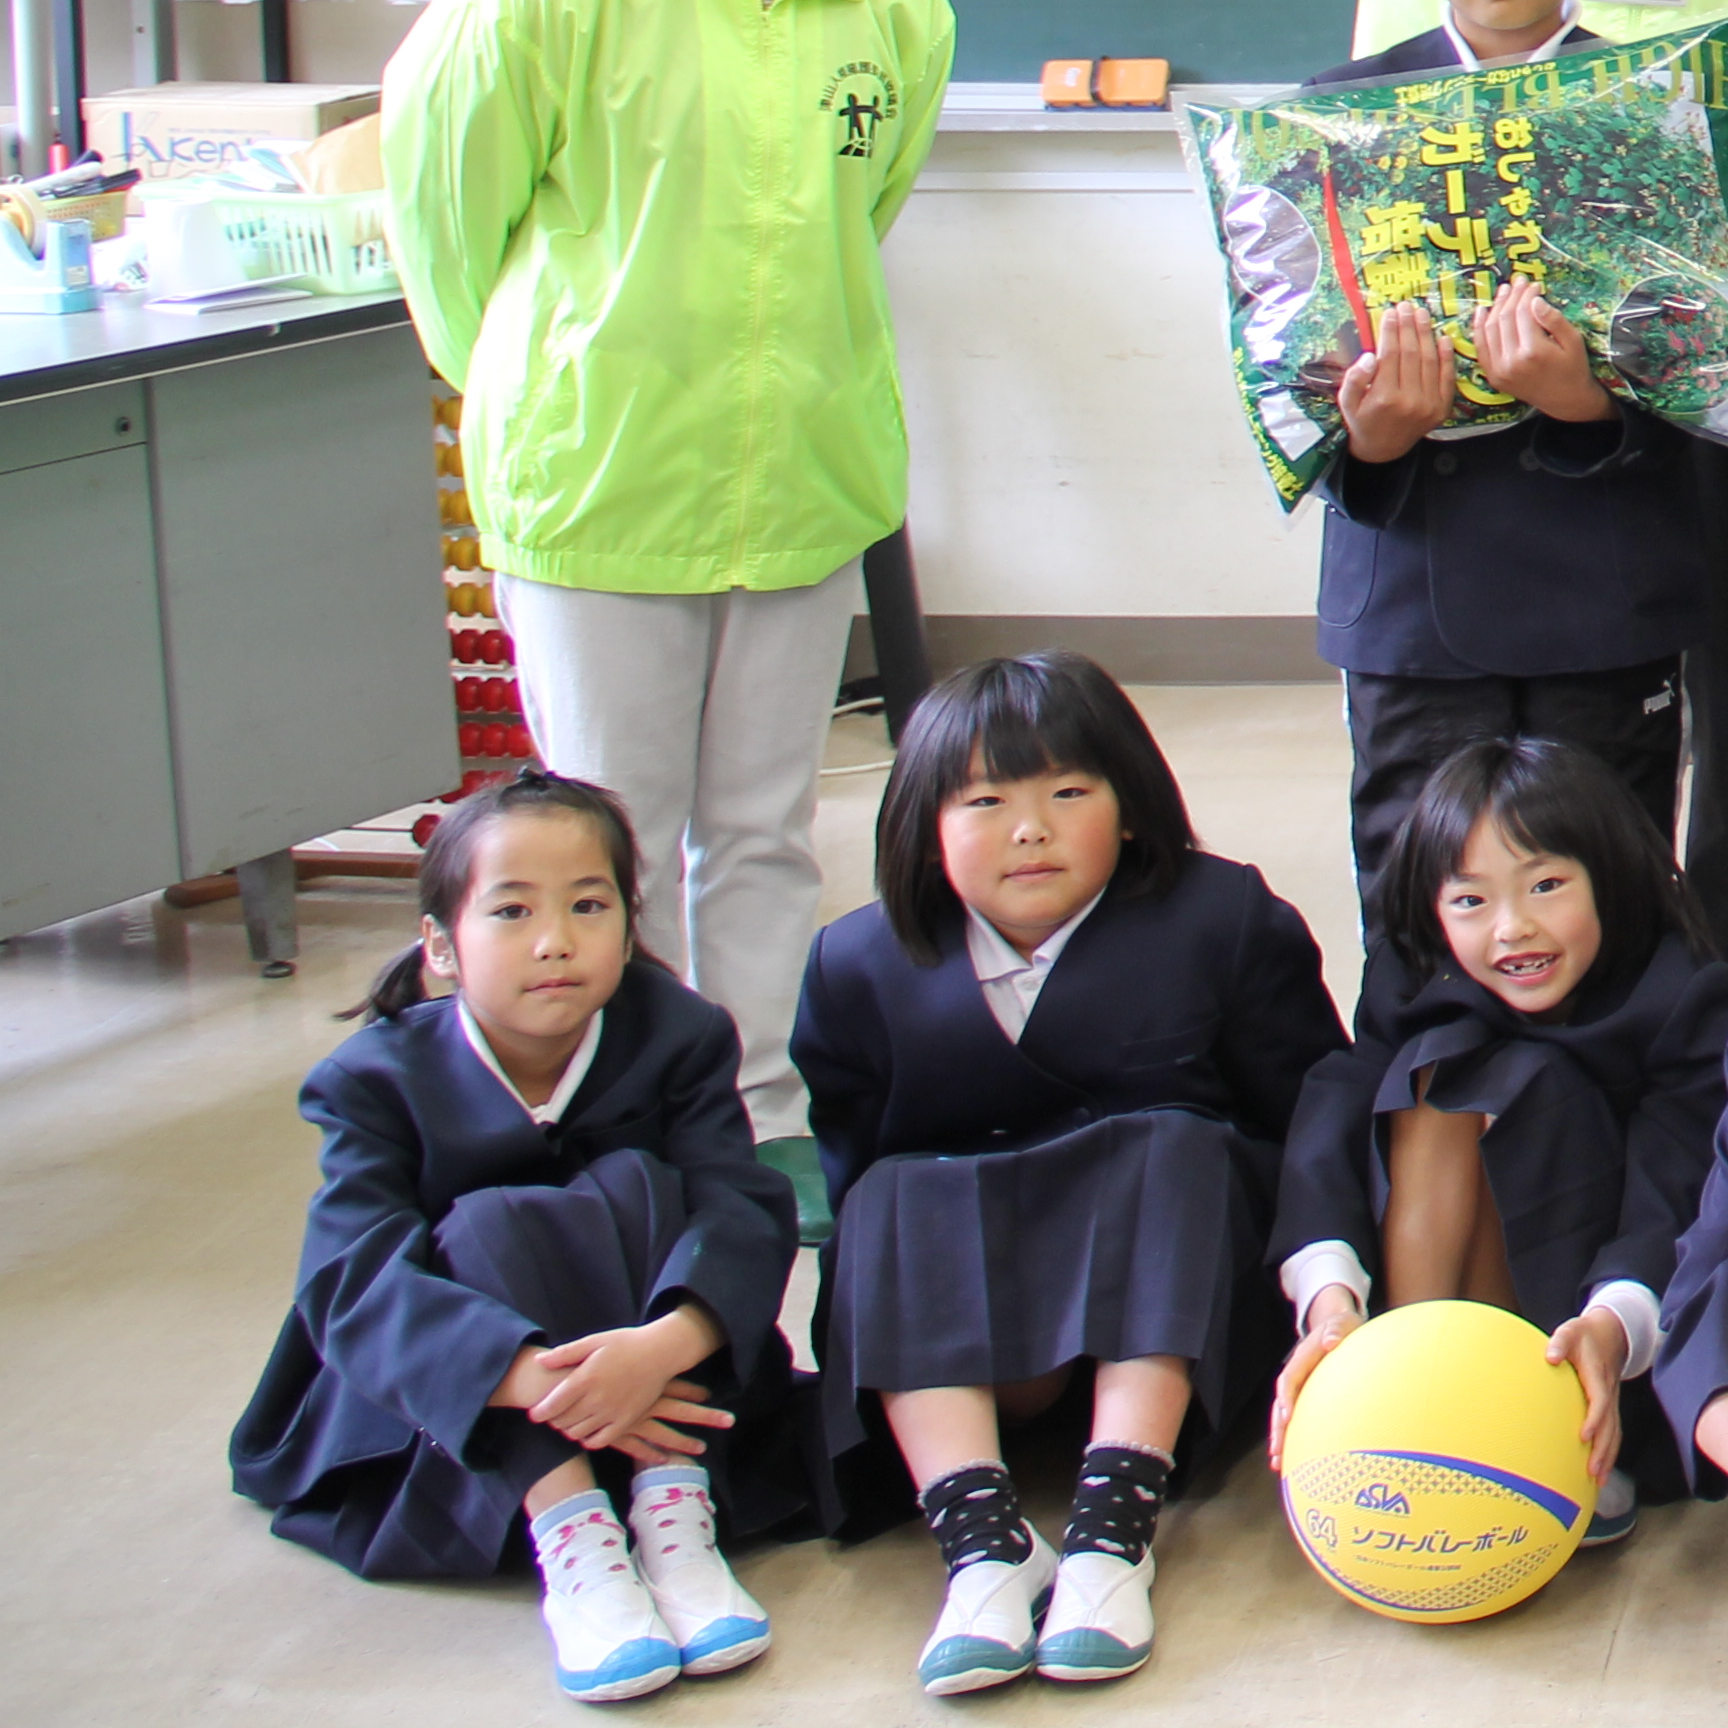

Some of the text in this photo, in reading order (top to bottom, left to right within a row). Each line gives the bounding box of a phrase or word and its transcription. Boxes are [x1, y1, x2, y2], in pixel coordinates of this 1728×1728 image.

[1352, 1525, 1529, 1554] ソフトバレーボール
